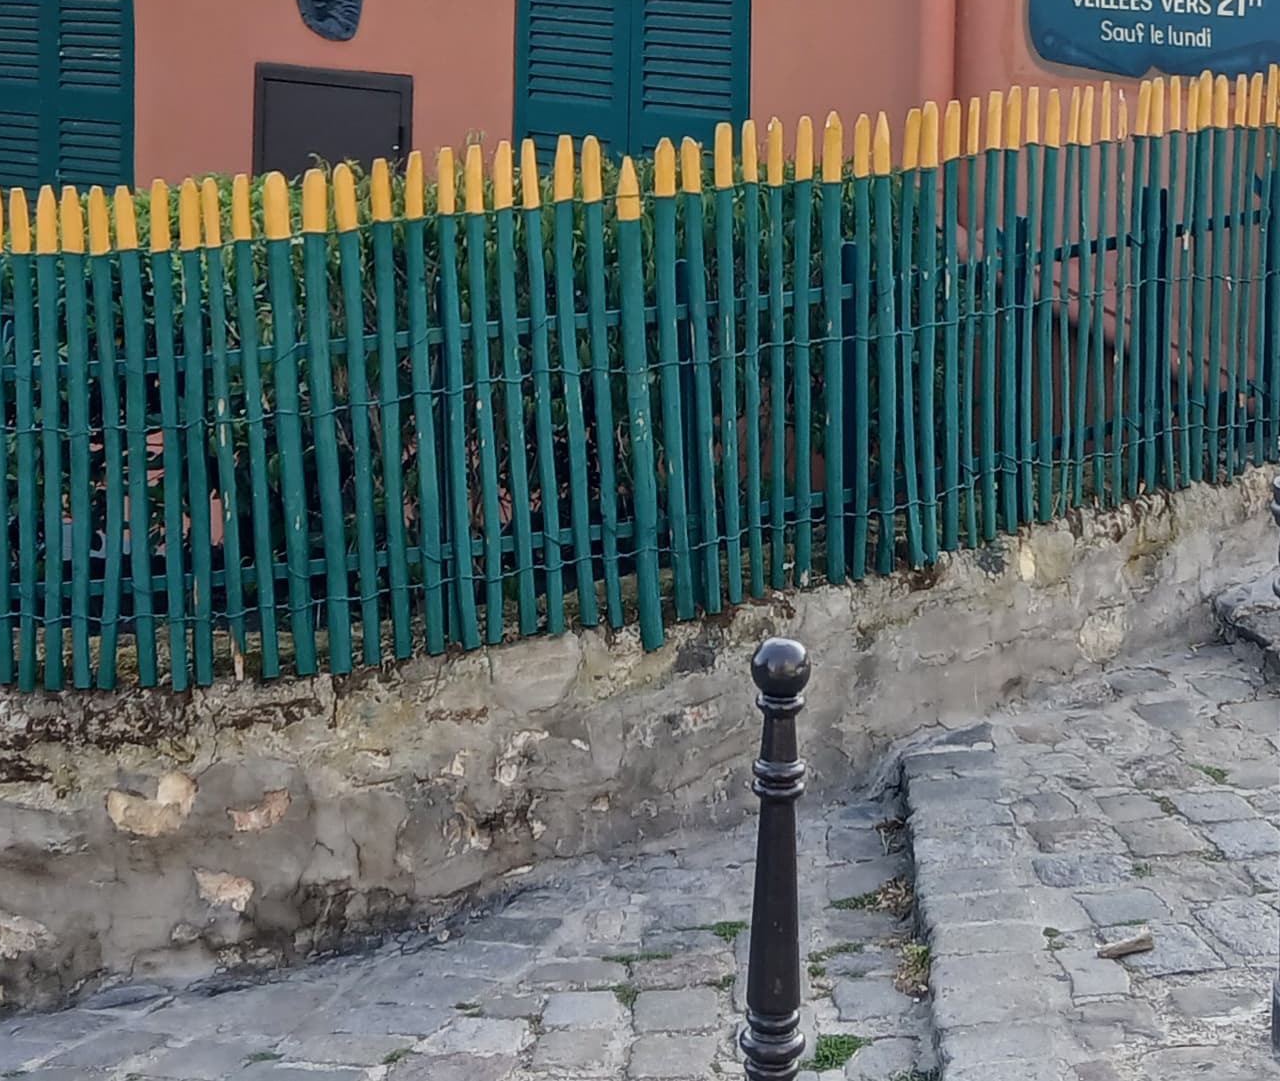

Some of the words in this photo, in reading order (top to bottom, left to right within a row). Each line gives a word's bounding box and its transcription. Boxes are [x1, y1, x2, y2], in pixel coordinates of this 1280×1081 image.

[1100, 20, 1145, 43] Sauf
[1149, 25, 1166, 44] le
[1167, 25, 1213, 48] lundi
